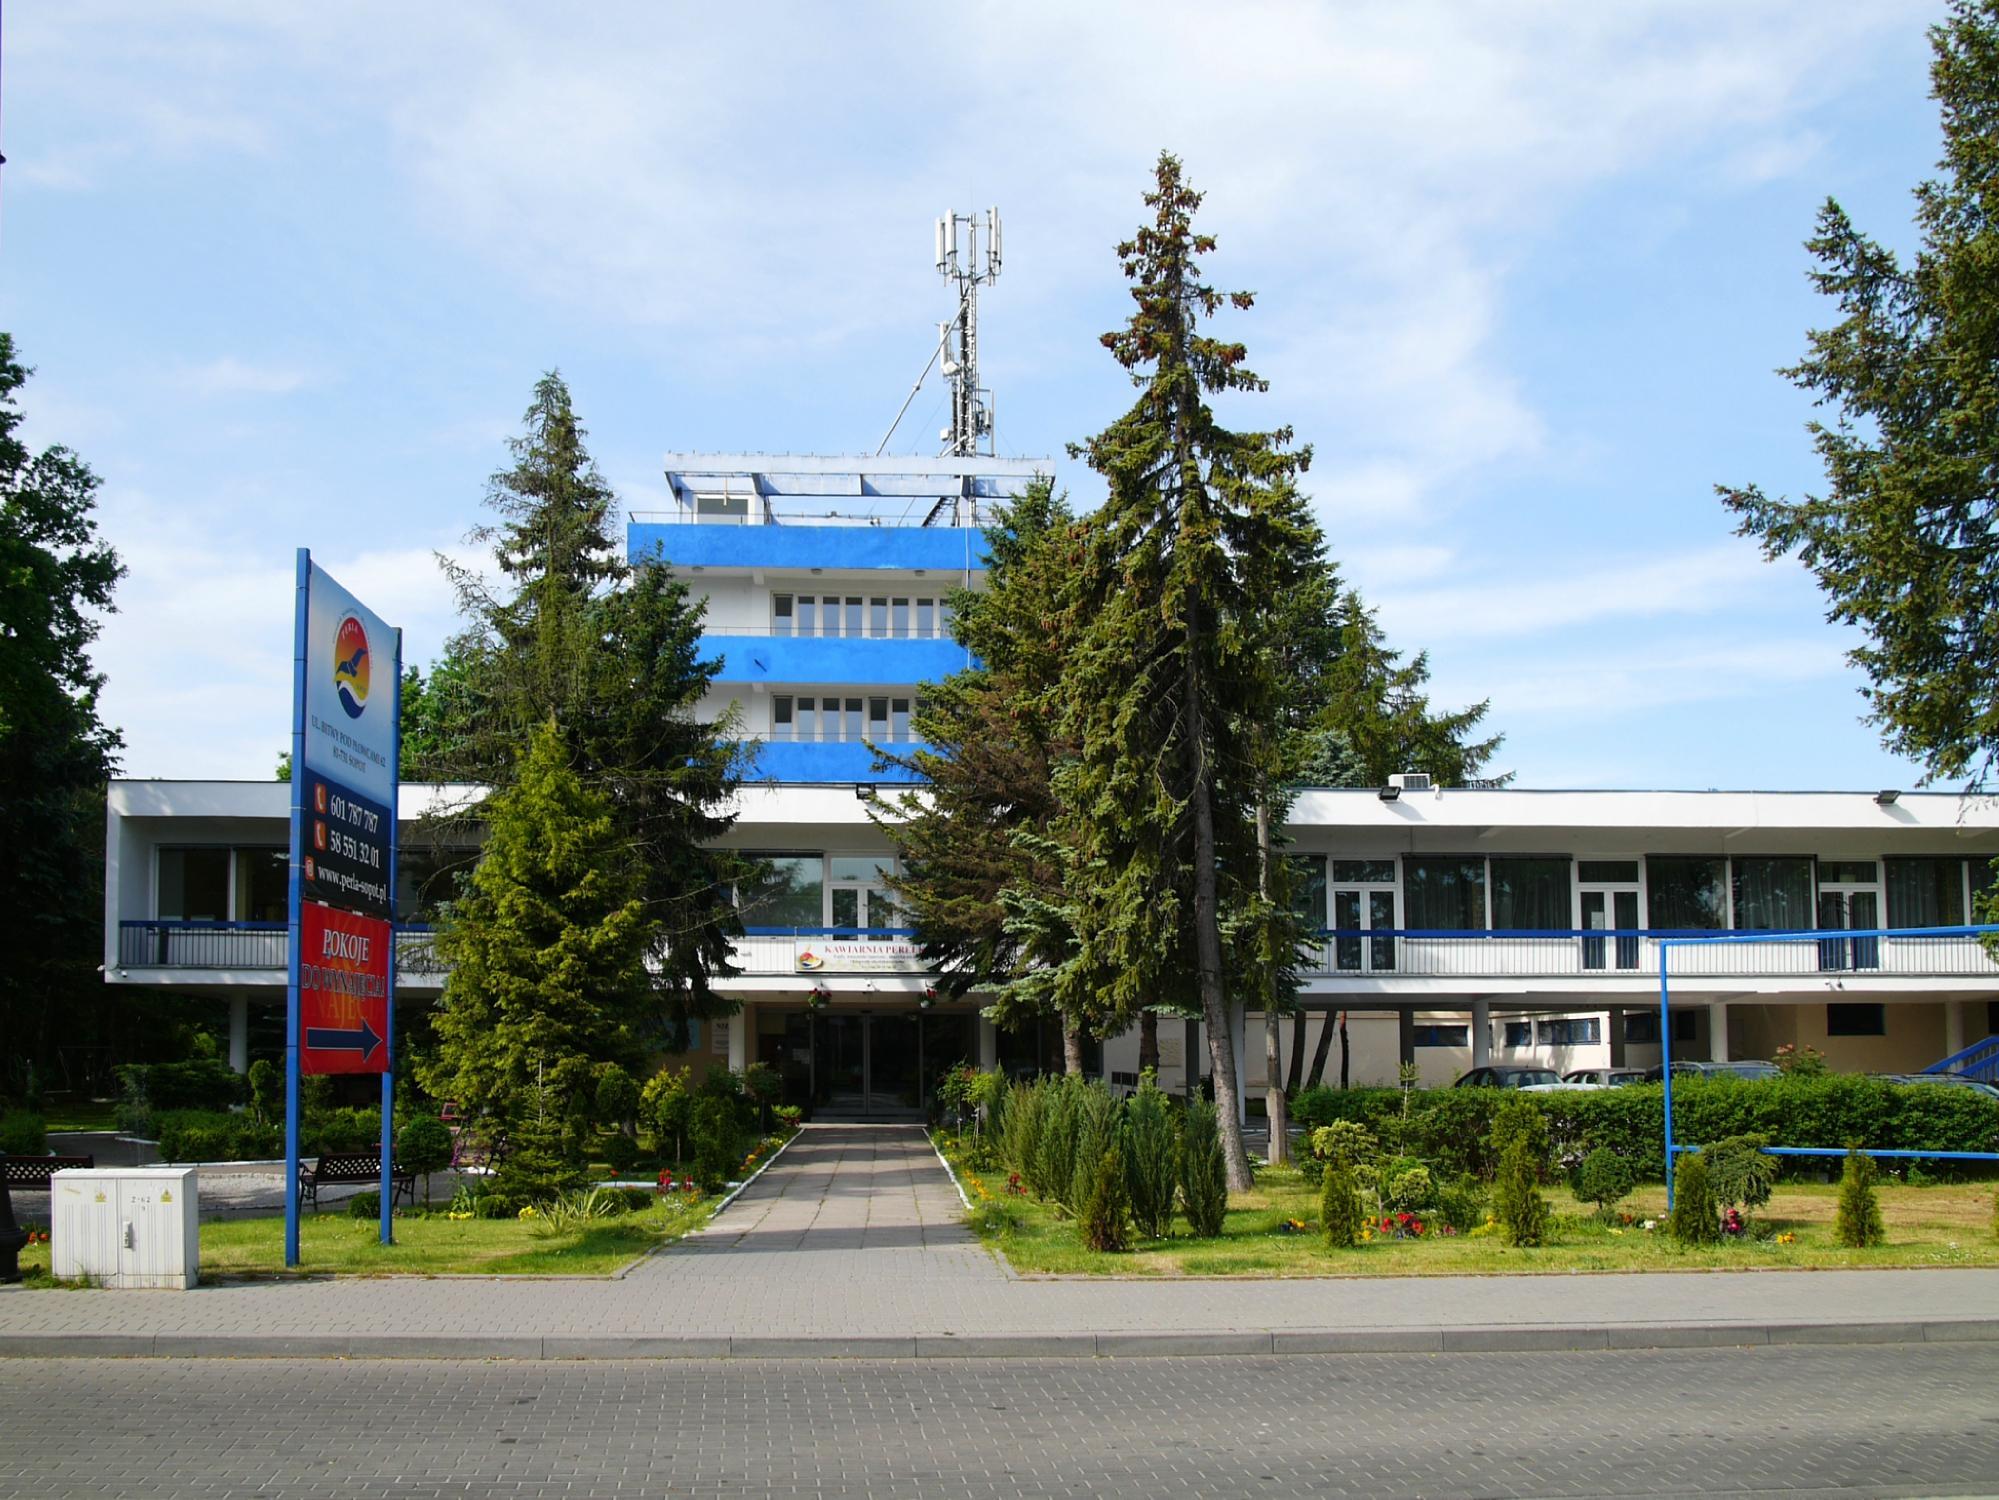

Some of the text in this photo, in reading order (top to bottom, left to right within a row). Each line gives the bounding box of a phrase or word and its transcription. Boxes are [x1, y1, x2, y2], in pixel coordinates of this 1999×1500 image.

[340, 731, 352, 748] POD
[331, 794, 379, 834] 601 787 787
[330, 829, 380, 869] 58 551 32 01
[318, 866, 387, 904] www.perla-sopot.pl
[323, 928, 370, 966] POKOJE
[825, 945, 883, 954] KAWIARNIA
[301, 963, 321, 991] DO
